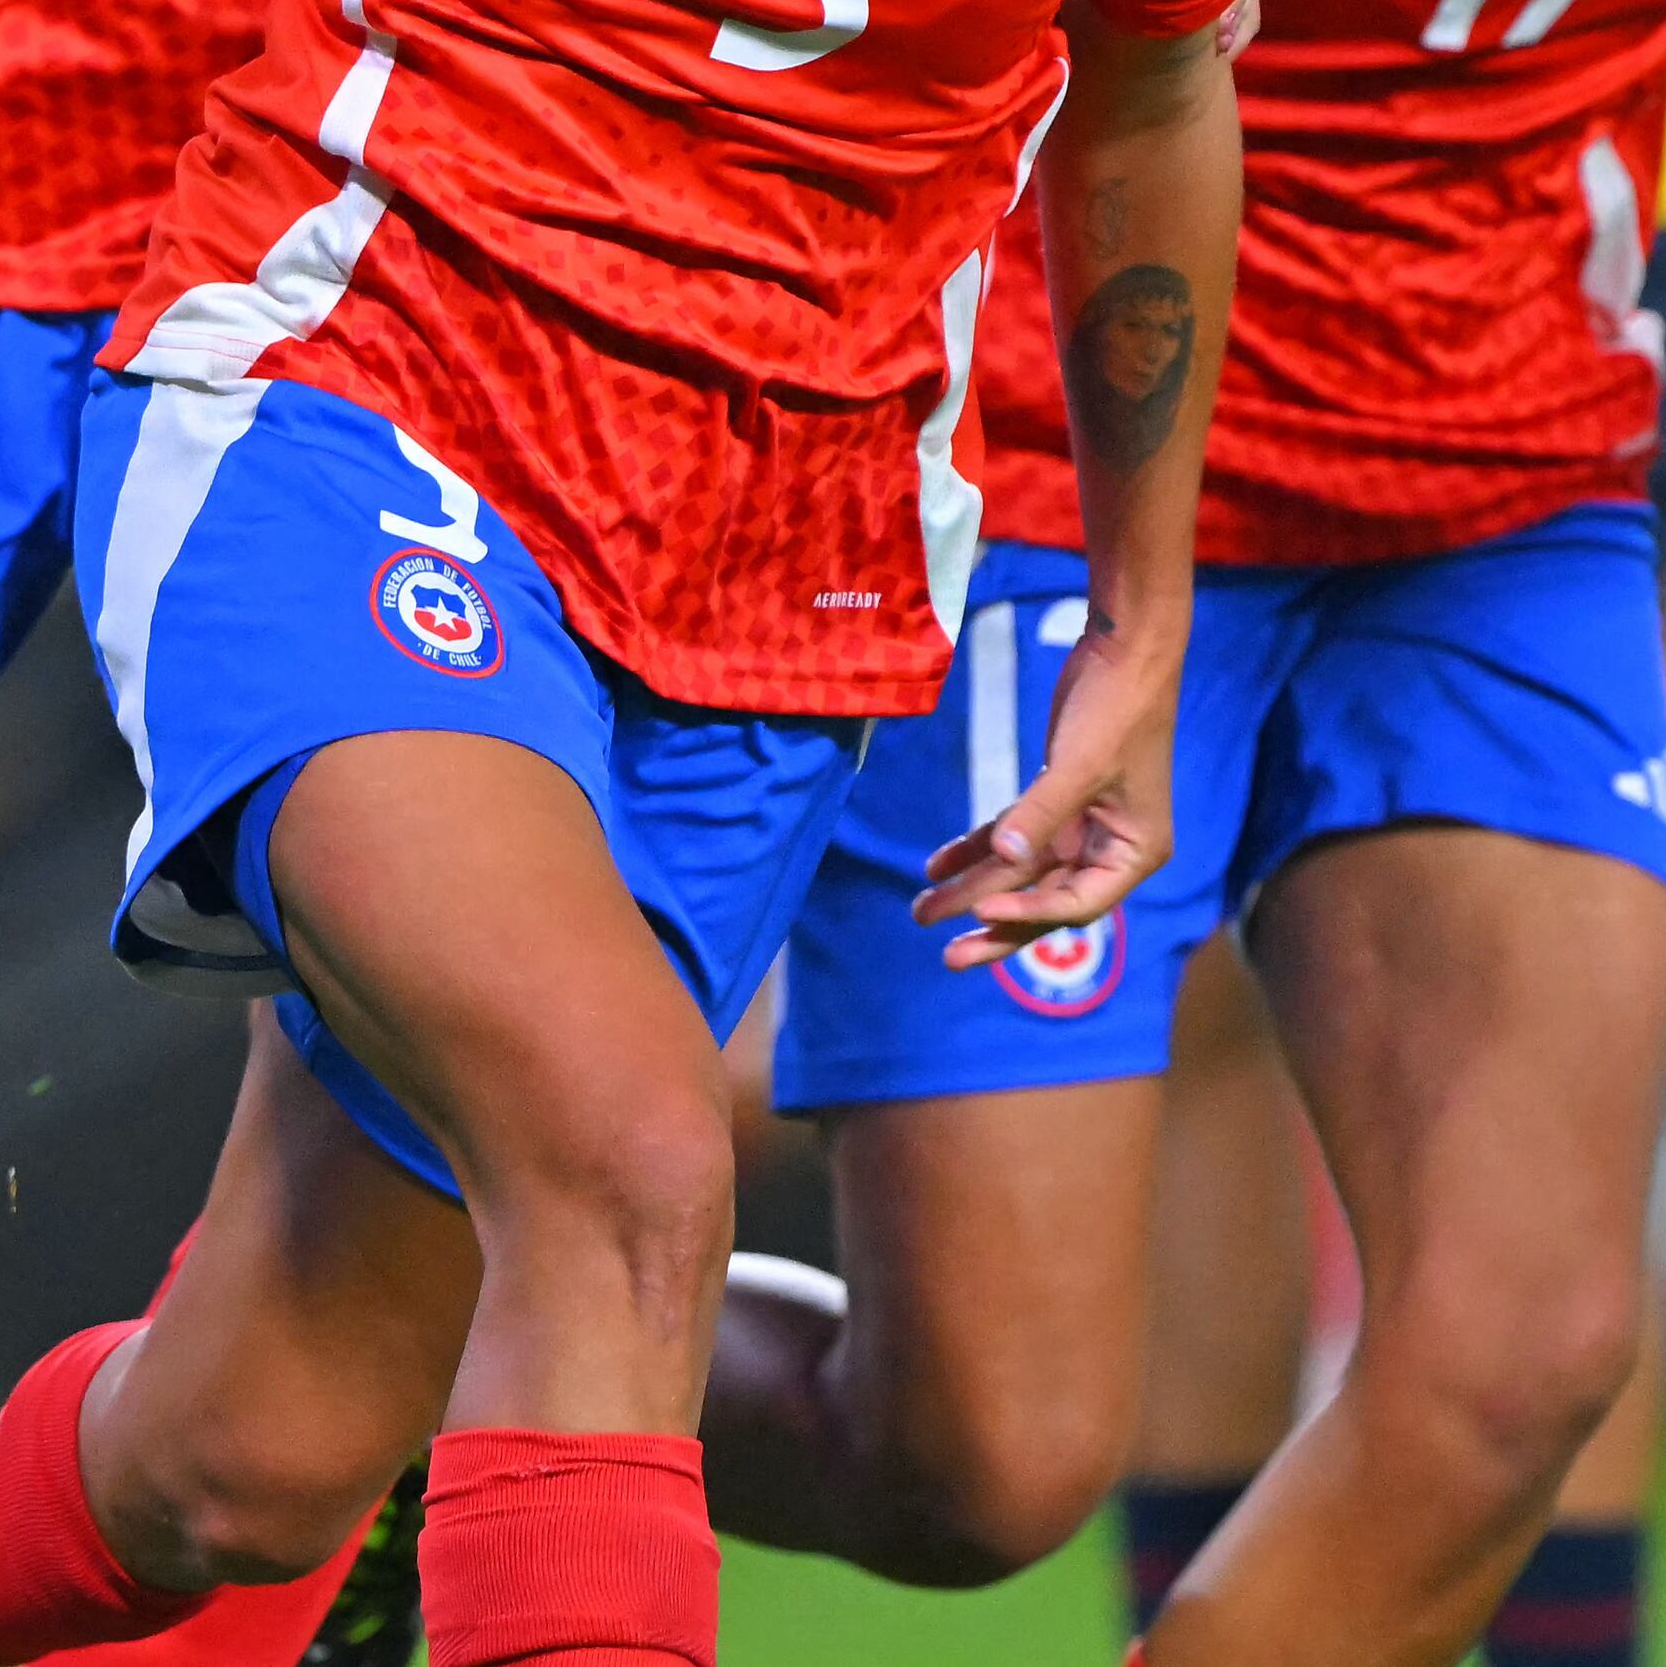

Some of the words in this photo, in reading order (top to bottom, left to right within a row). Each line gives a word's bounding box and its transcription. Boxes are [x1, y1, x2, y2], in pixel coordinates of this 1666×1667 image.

[383, 557, 435, 609] FEDERACION
[442, 564, 459, 582] DE
[462, 582, 492, 630] FUTBOL
[422, 643, 440, 660] DE
[448, 652, 482, 667] CHILE
